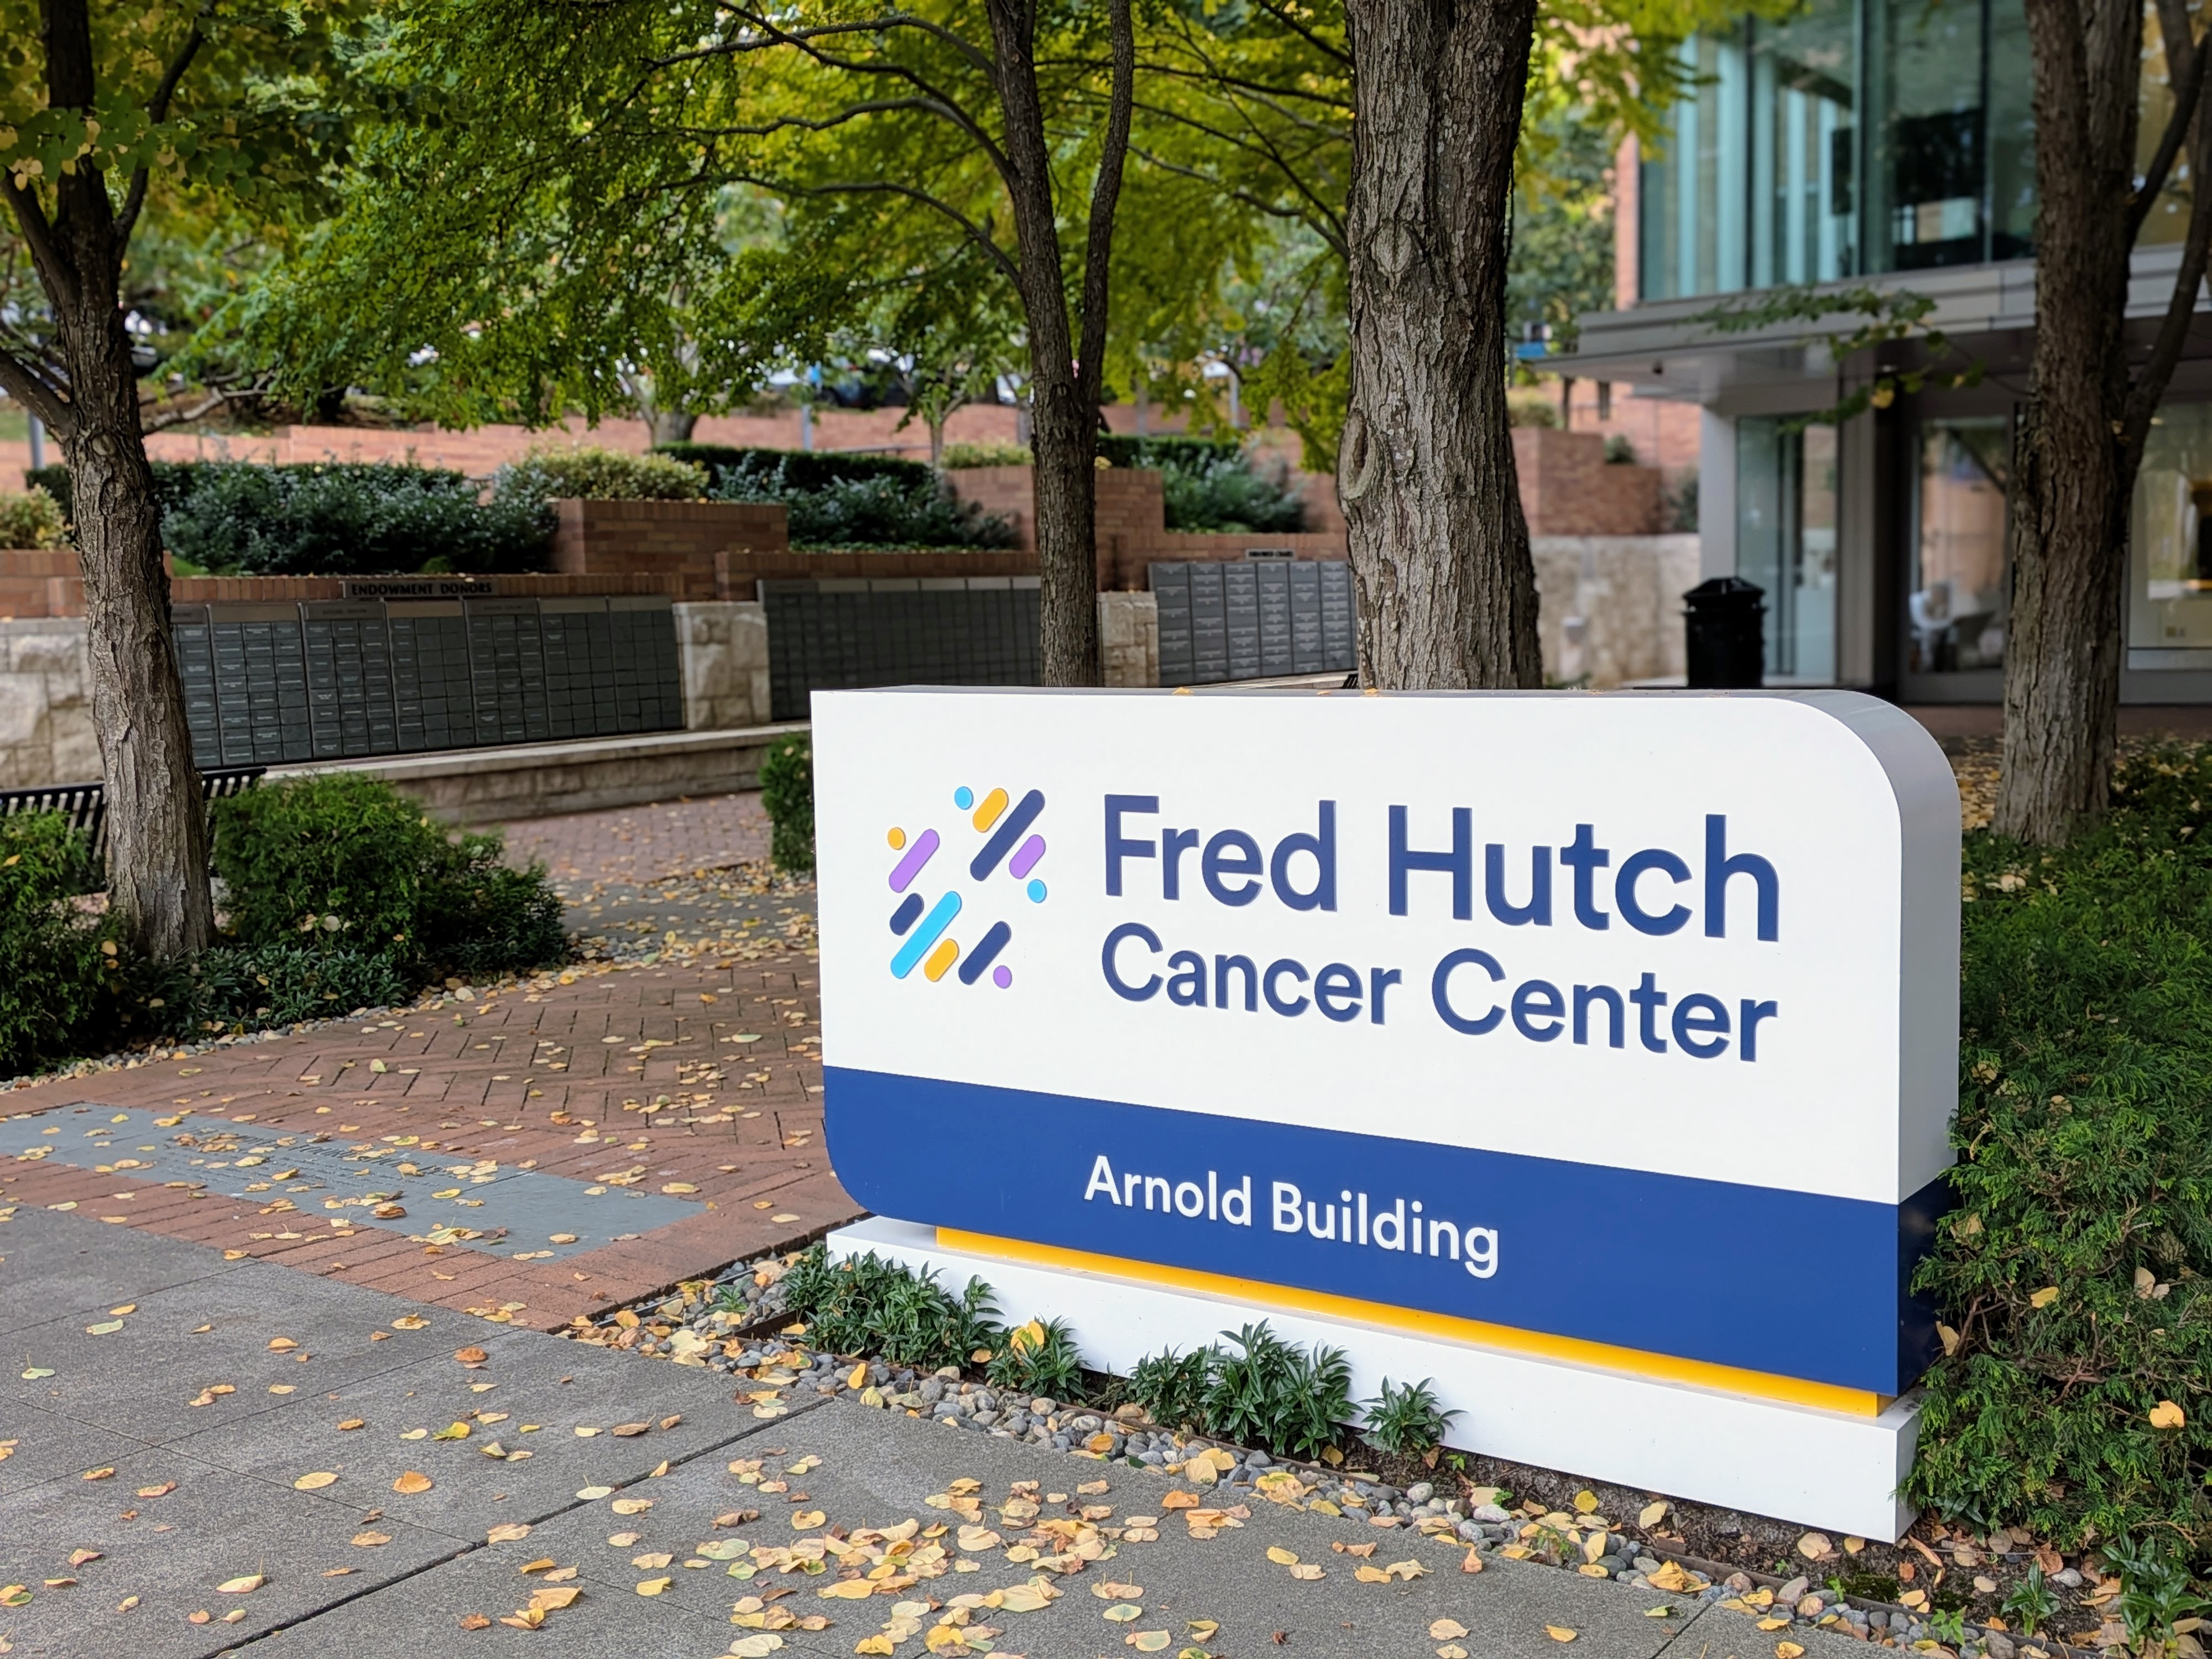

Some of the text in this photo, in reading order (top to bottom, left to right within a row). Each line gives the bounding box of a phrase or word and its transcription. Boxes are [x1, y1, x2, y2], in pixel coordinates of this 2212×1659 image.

[351, 582, 492, 596] ENDOWMENT DONORS
[1105, 794, 1780, 943] Fred Hutch
[1102, 922, 1778, 1062] Cancer Center
[1084, 1155, 1498, 1279] Arnold Building
